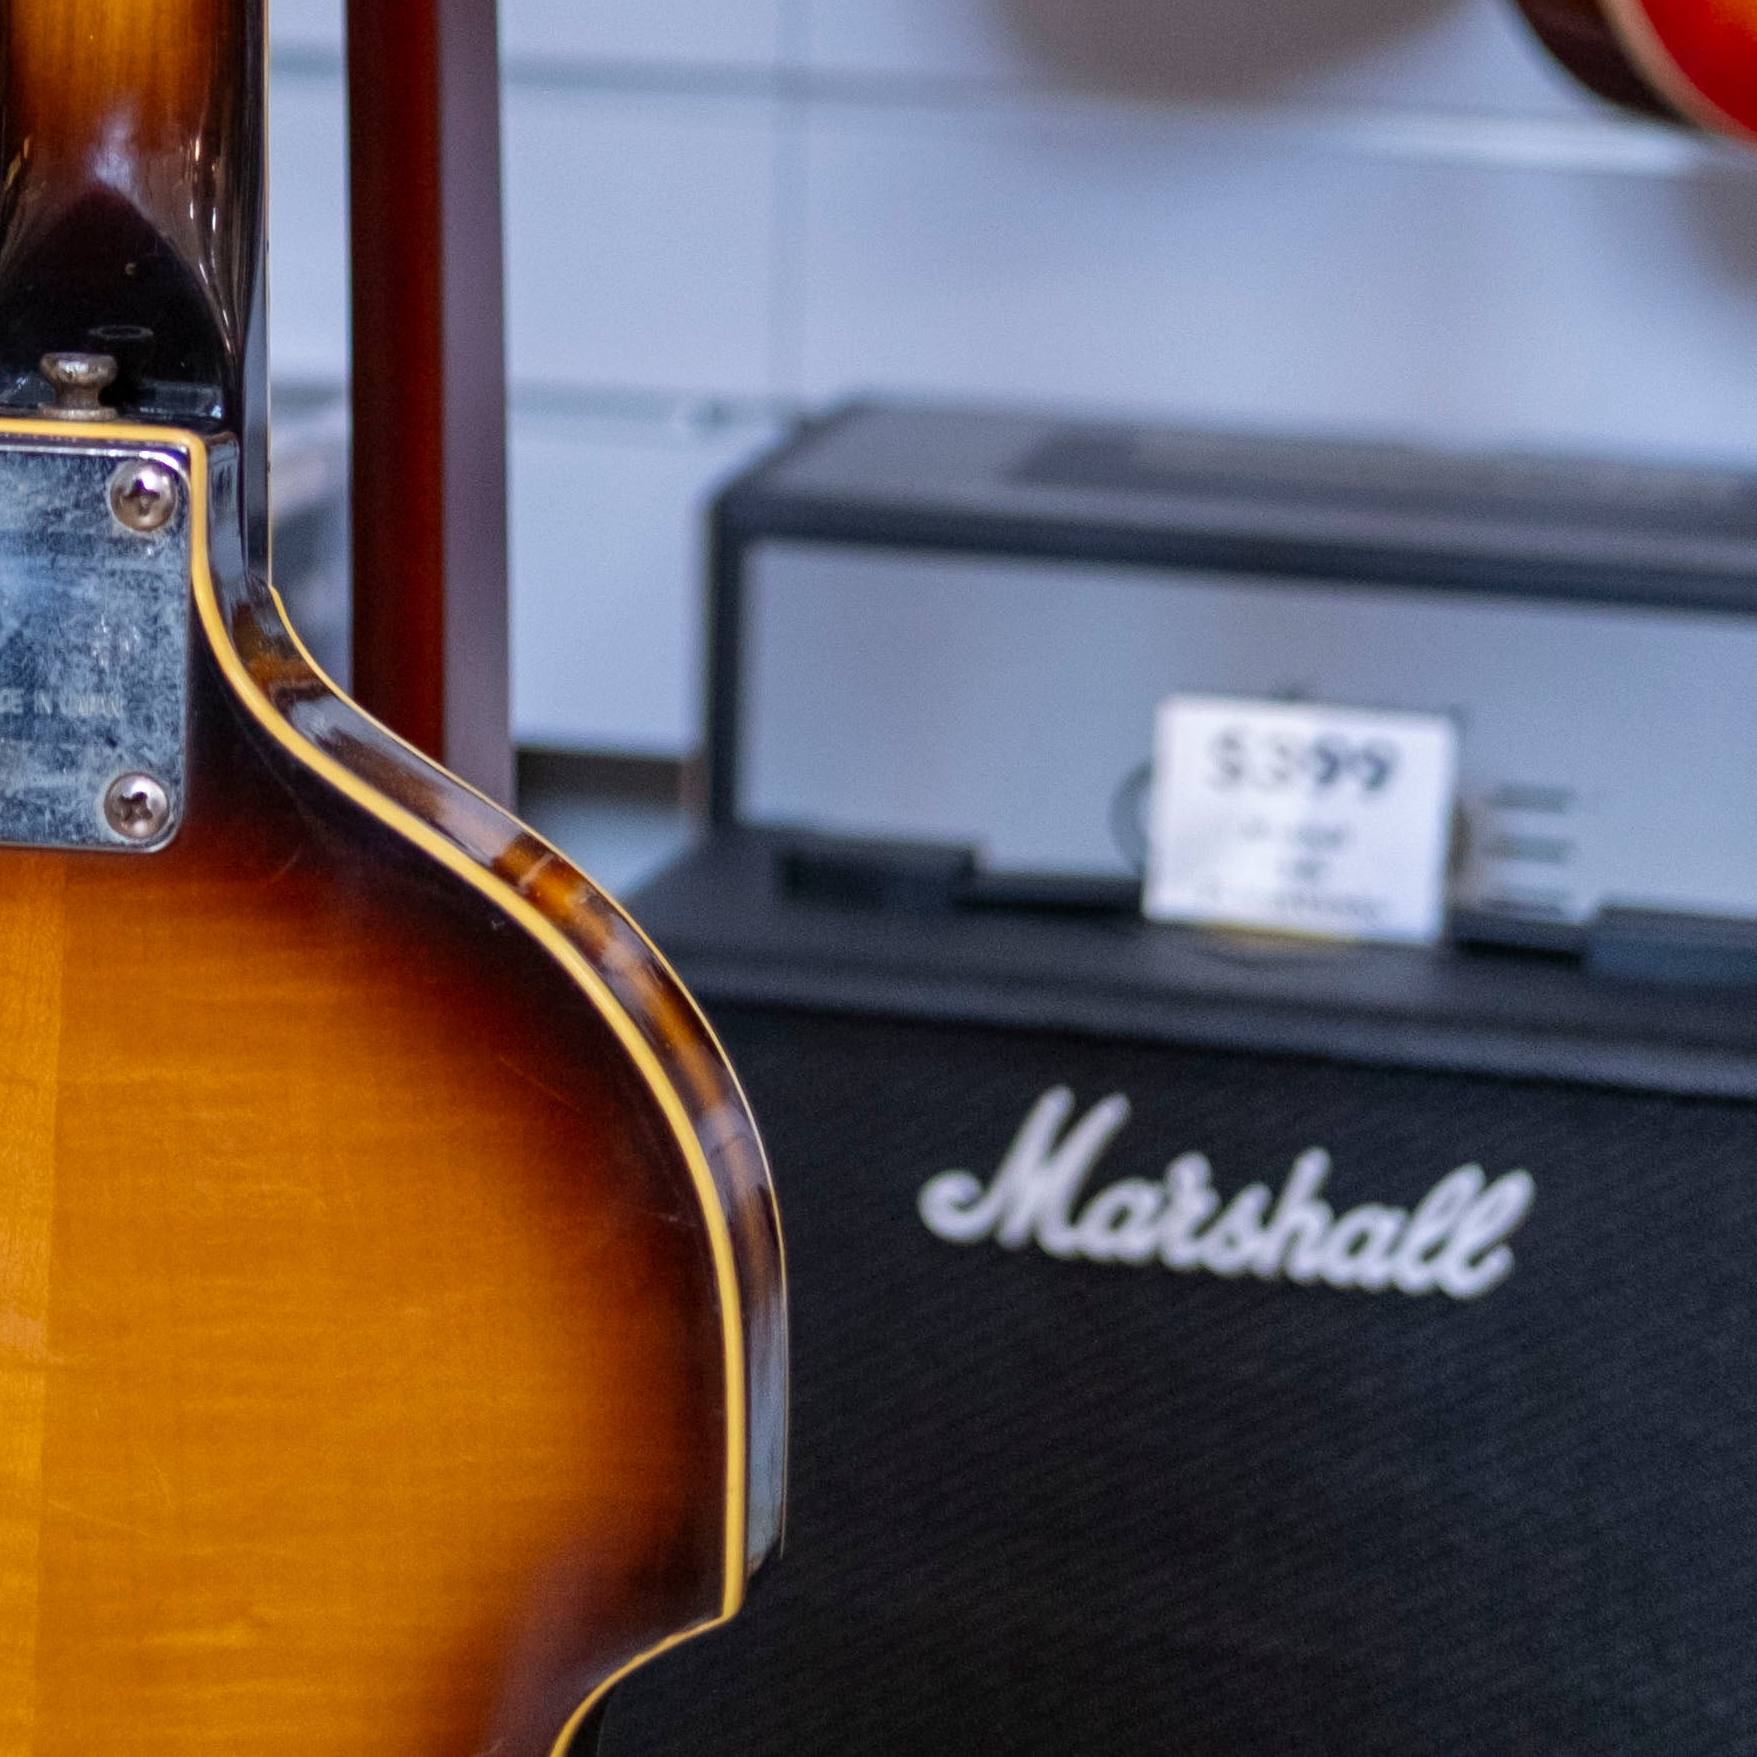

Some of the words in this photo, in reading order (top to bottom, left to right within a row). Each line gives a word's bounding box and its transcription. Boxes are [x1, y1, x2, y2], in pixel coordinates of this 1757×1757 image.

[34, 688, 54, 715] IN
[1210, 726, 1400, 799] $399
[918, 1086, 1536, 1299] Marshall
